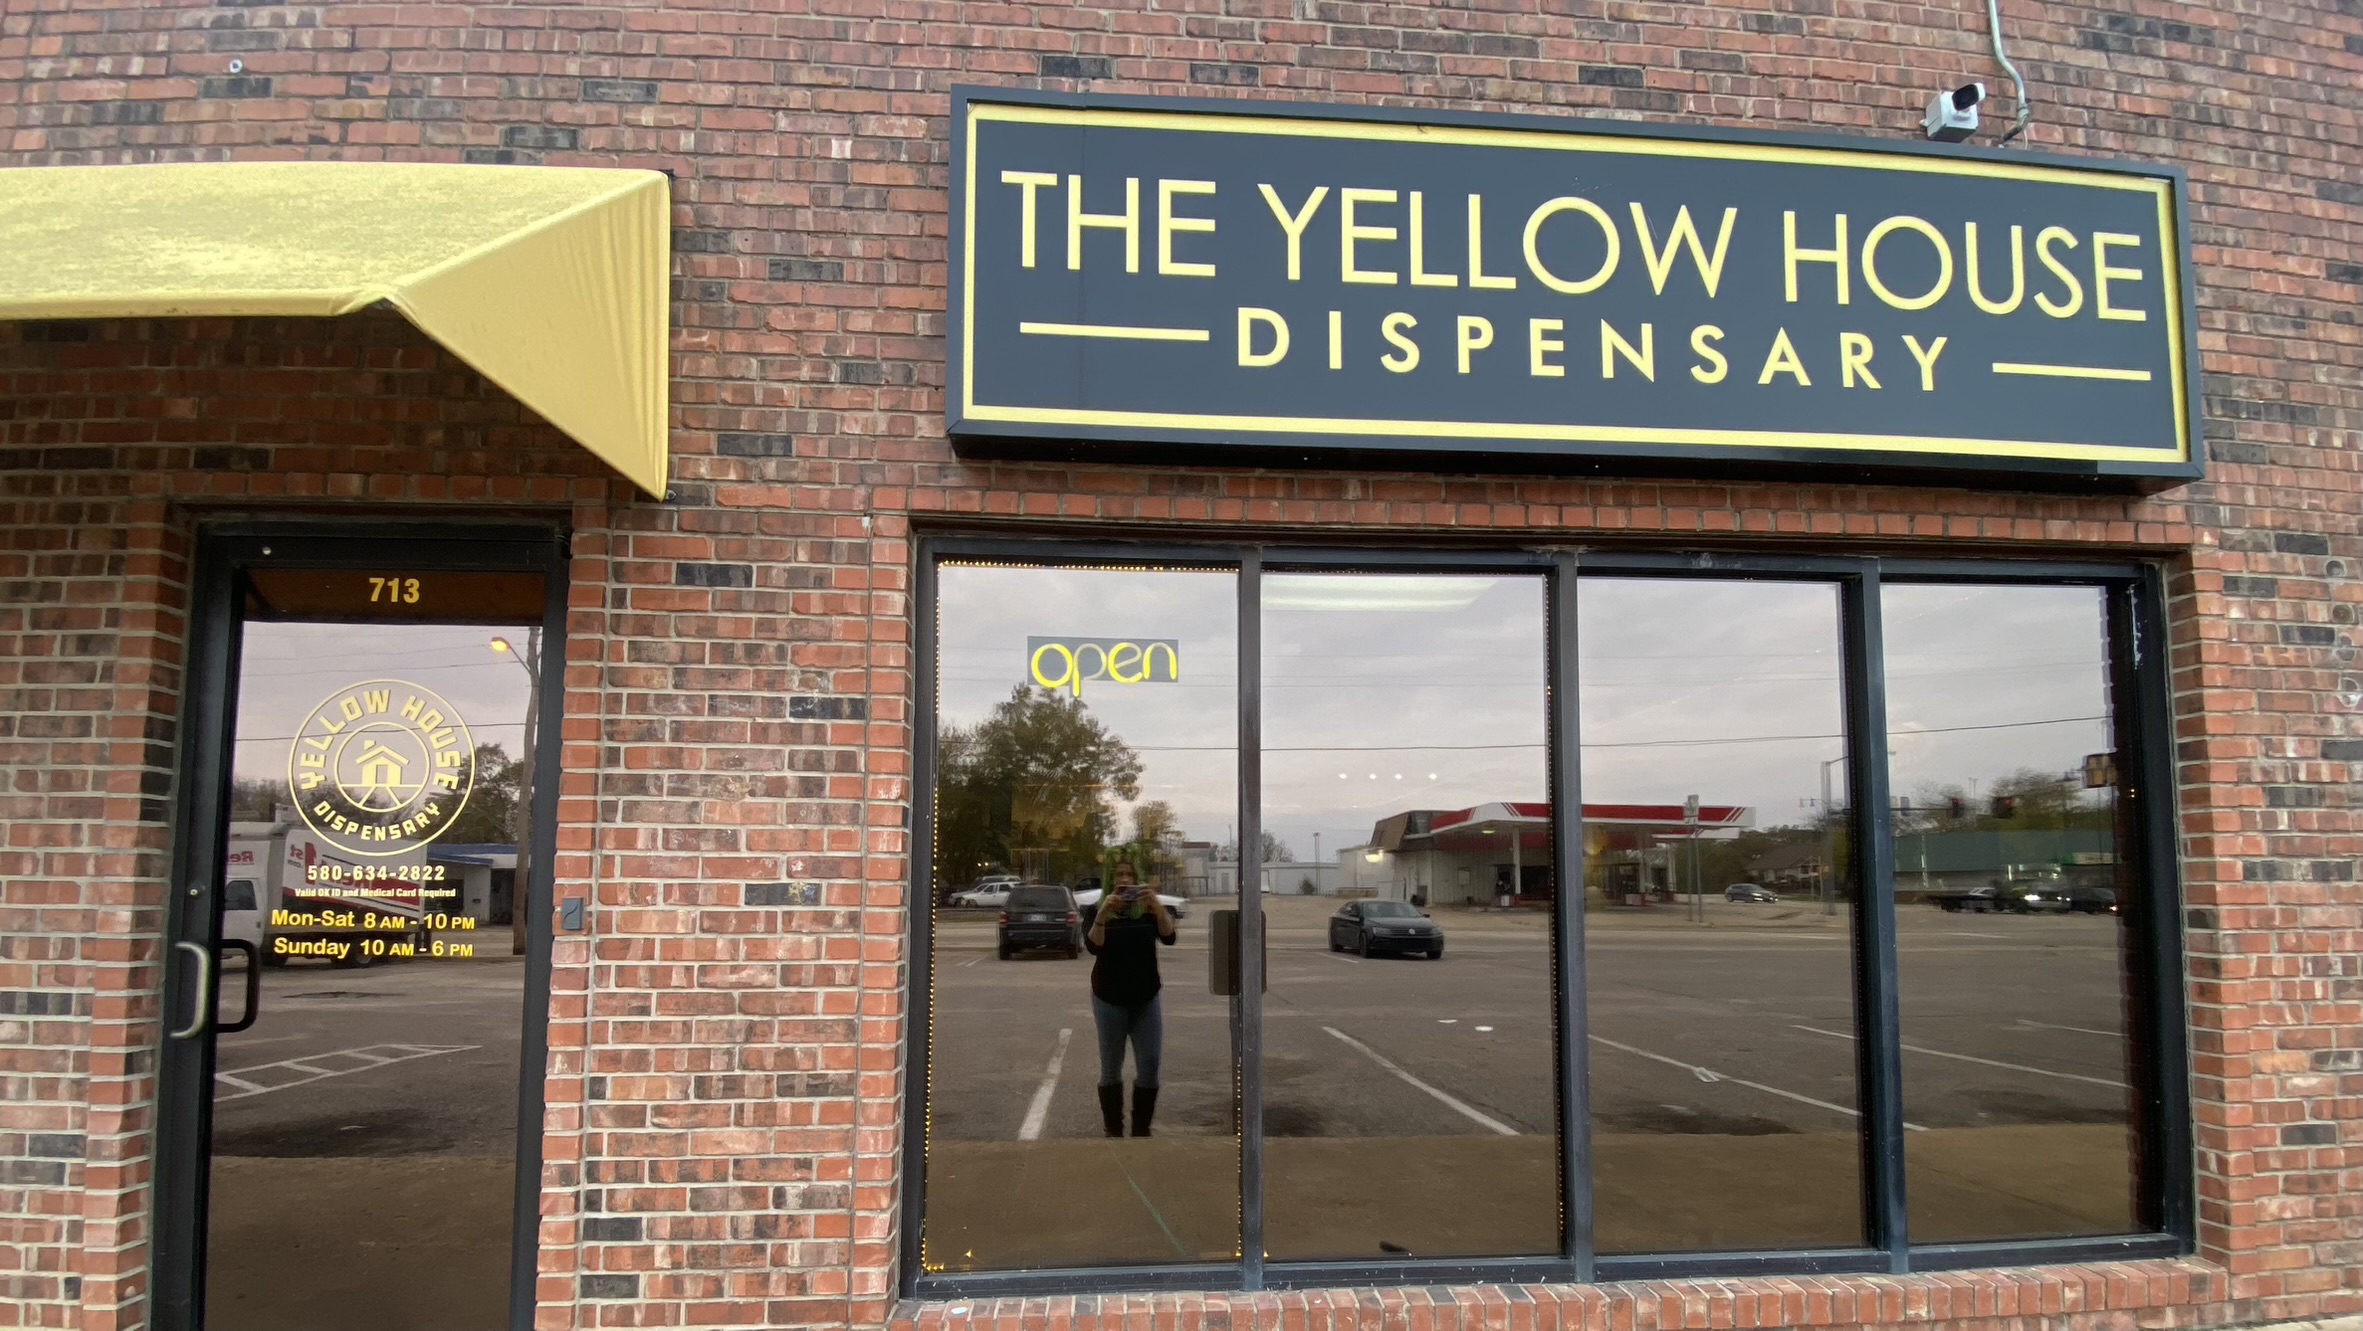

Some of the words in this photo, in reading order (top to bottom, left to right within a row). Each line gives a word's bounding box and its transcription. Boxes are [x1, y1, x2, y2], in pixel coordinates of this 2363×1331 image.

[1001, 171, 1216, 277] THE
[1257, 183, 1737, 298] YELLOW
[1783, 210, 2147, 322] HOUSE
[1237, 307, 1948, 391] DISPENSARY
[368, 577, 420, 604] 713
[1031, 642, 1177, 696] open
[299, 689, 391, 790] YELLOW
[400, 695, 461, 790] HOUSE
[313, 800, 441, 841] DISPENSARY
[307, 865, 445, 881] 580-634-2822
[295, 888, 316, 898] Valid
[317, 888, 331, 898] OK
[331, 888, 341, 898] ID
[342, 888, 359, 898] and
[360, 888, 395, 898] Medical
[396, 888, 417, 898] Card
[418, 888, 456, 899] Required
[271, 909, 355, 927] Mon-Sat
[363, 912, 376, 929] 8
[379, 916, 405, 929] AM
[424, 913, 447, 929] 10
[451, 917, 475, 930] PM
[274, 937, 350, 959] Sunday
[360, 939, 384, 955] 10
[389, 943, 414, 956] AM
[432, 940, 444, 957] 6
[450, 943, 473, 957] PM
